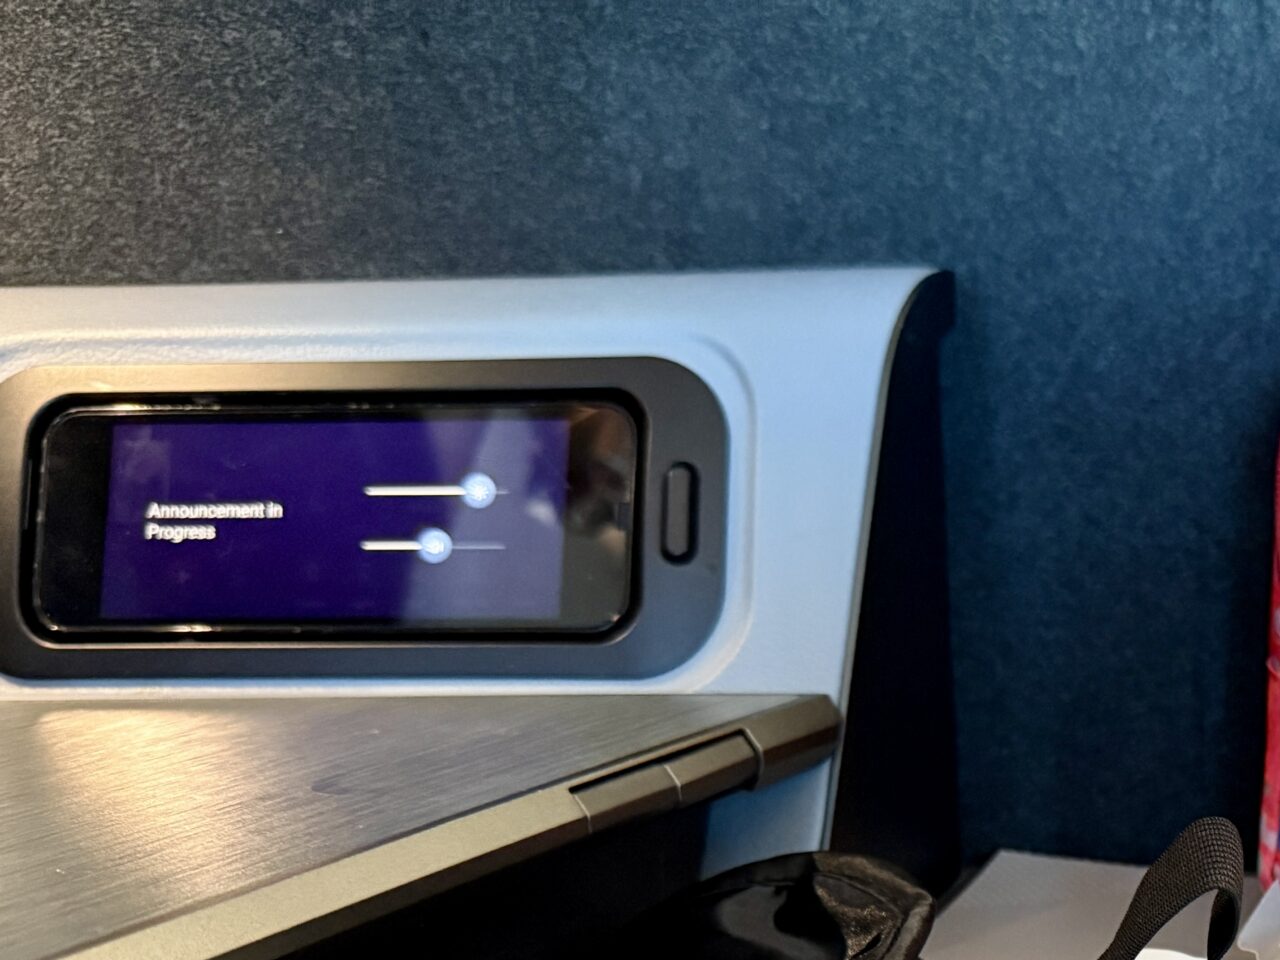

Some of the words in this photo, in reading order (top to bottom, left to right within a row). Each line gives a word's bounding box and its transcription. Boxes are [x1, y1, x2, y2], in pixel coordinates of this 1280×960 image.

[145, 502, 265, 519] Announcement
[266, 502, 284, 519] in
[144, 522, 217, 543] Progress
